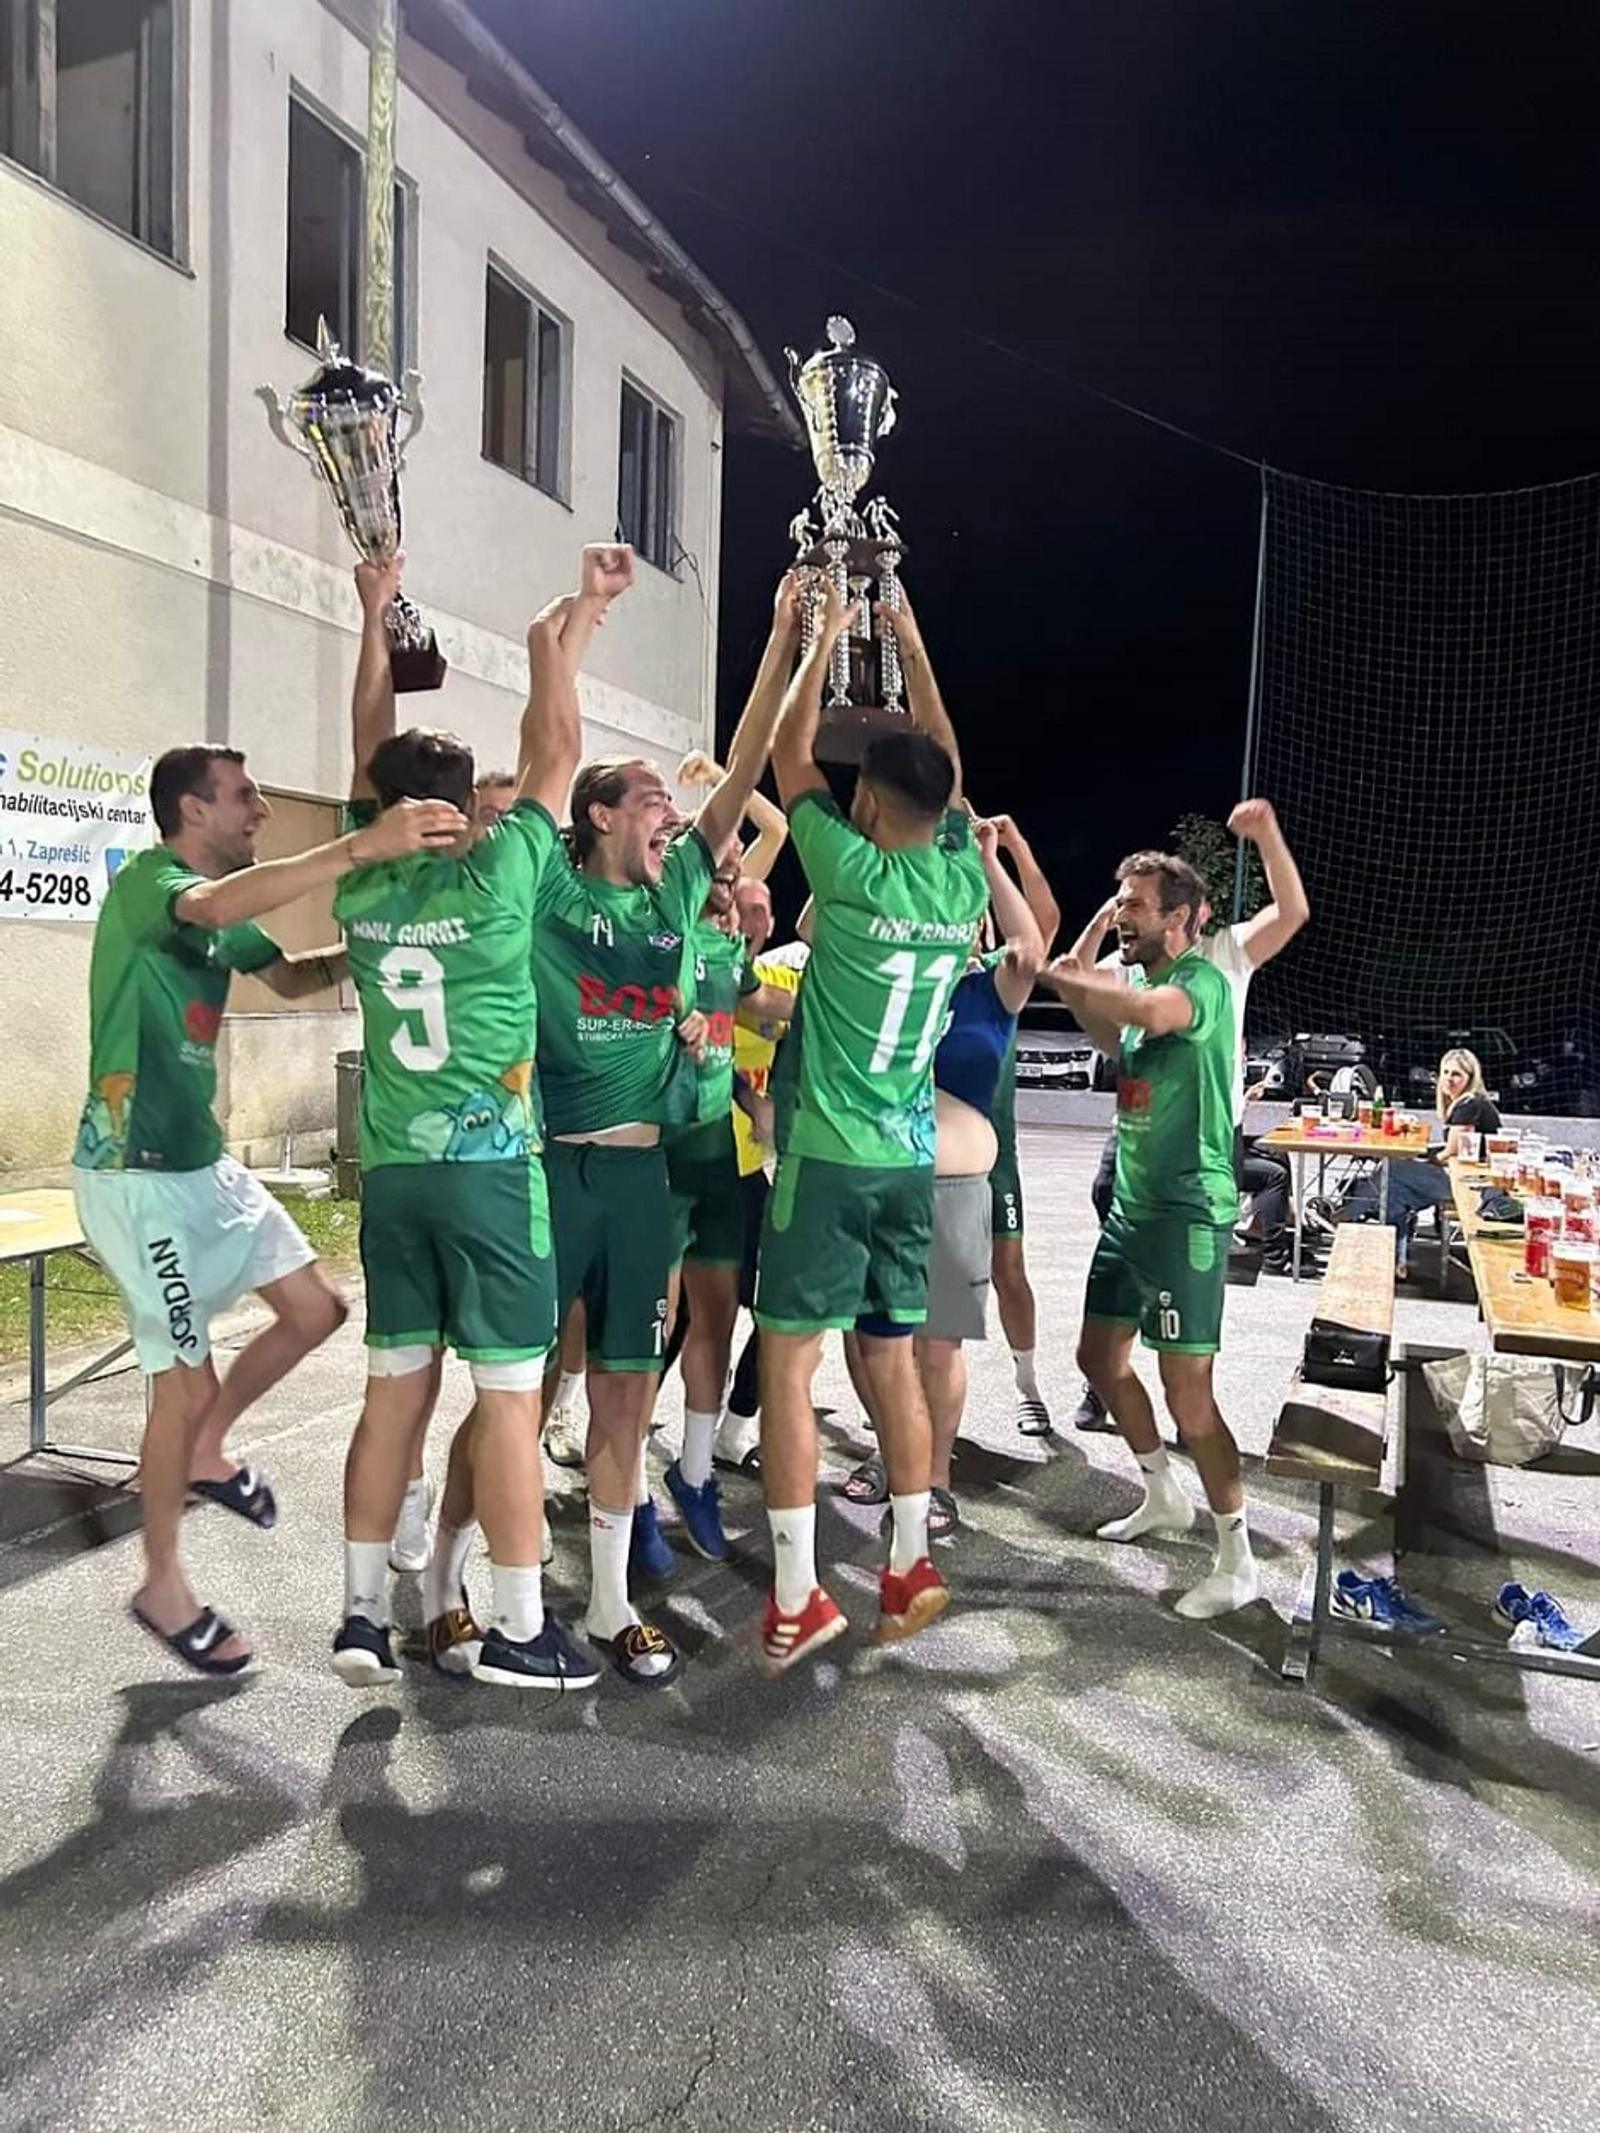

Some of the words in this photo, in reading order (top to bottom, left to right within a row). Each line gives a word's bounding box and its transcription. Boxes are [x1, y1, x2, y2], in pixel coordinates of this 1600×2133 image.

[17, 750, 145, 796] Solutions
[107, 808, 146, 825] centar
[27, 840, 91, 864] Zaprešić
[0, 869, 91, 906] 4-5298
[592, 913, 614, 947] 14
[377, 946, 450, 1072] 9
[868, 951, 958, 1073] 11
[1006, 1206, 1018, 1229] 8
[148, 1237, 198, 1349] JORDAN
[1160, 1309, 1180, 1340] 10
